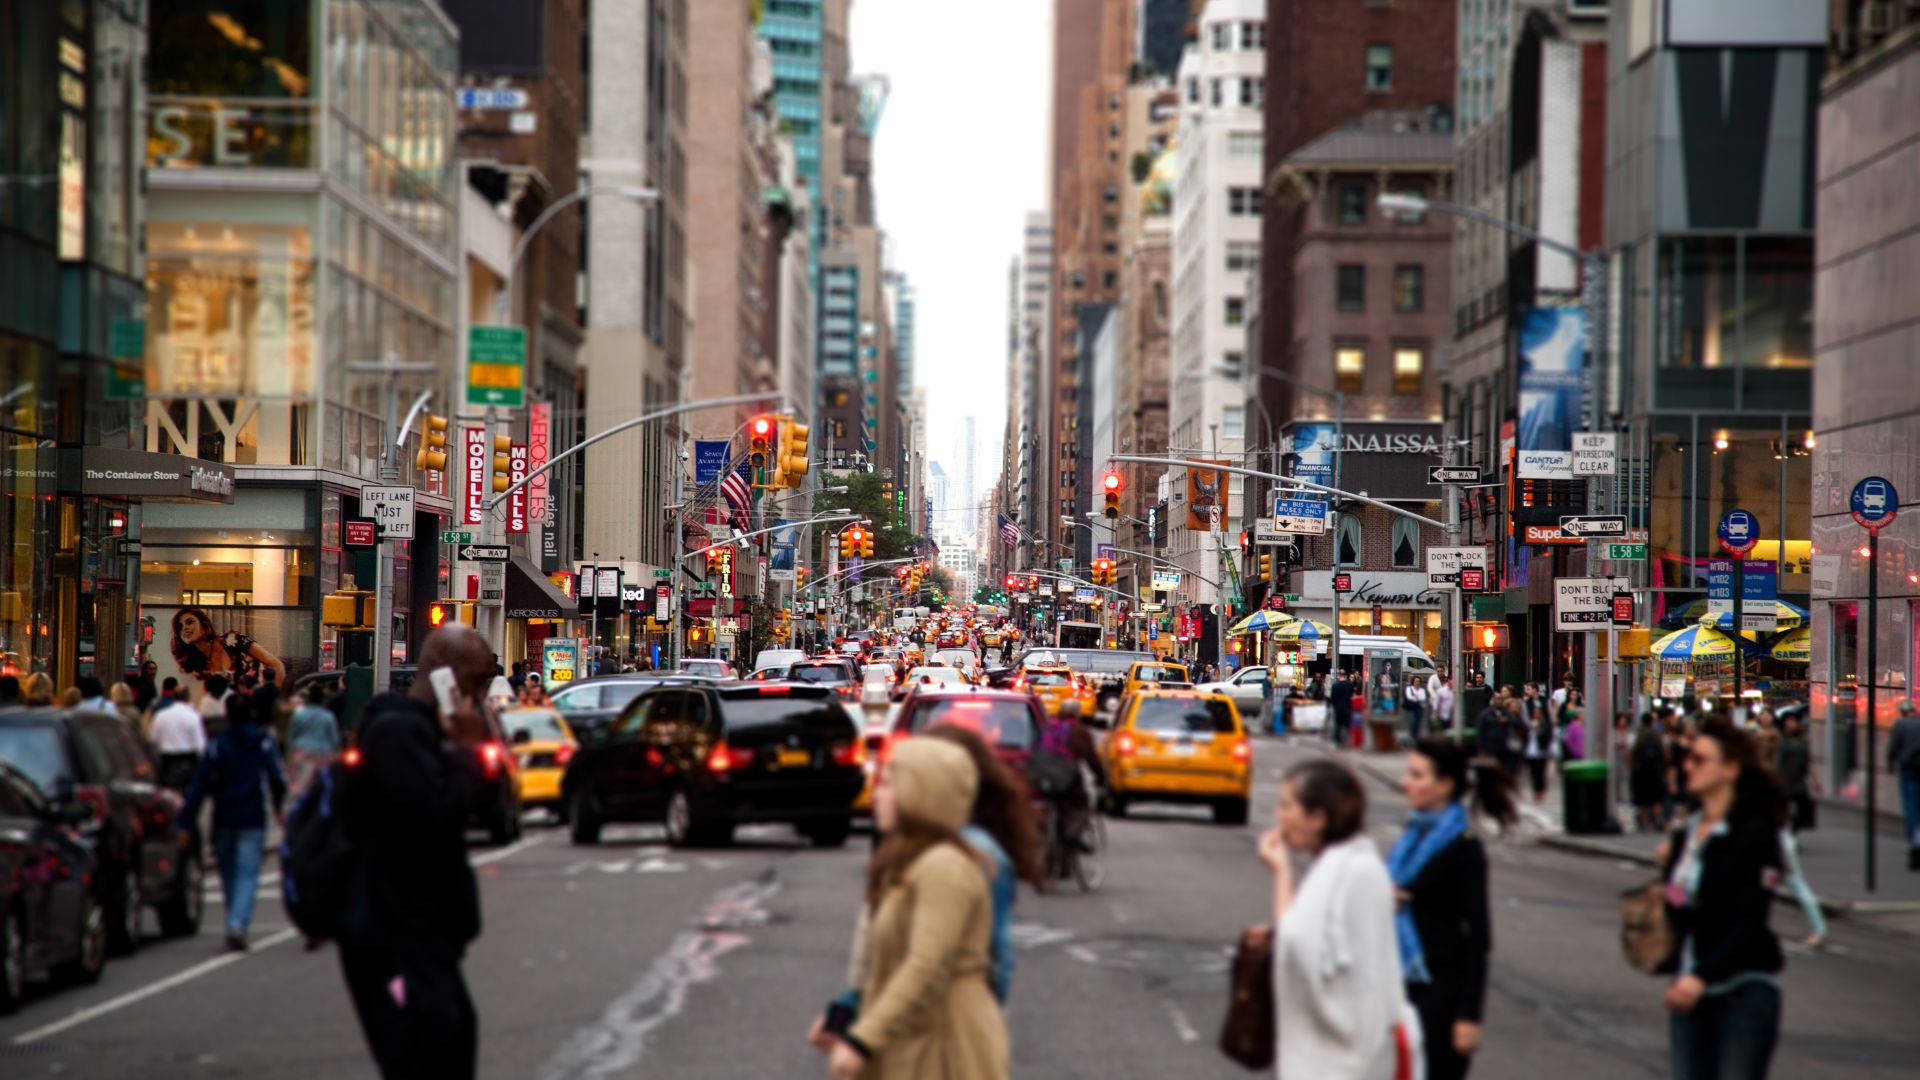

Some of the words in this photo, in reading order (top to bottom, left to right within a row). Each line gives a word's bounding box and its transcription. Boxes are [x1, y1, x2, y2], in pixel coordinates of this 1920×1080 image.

[146, 398, 258, 462] NY
[1333, 433, 1440, 454] ENAISSA
[1582, 438, 1605, 447] KEEP
[530, 404, 547, 518] AEROSOLES
[1580, 462, 1608, 471] CLEAR
[86, 470, 104, 479] The
[105, 470, 152, 480] Container
[154, 471, 180, 480] Store
[469, 430, 485, 522] MODELLS
[390, 493, 410, 501] LANE
[1568, 523, 1588, 531] ONE
[444, 534, 449, 542] E
[451, 534, 460, 543] 58
[545, 533, 557, 556] nail
[1612, 546, 1617, 557] E
[1621, 546, 1632, 557] 58
[1710, 562, 1729, 571] M101
[1710, 575, 1729, 584] M102
[1561, 586, 1588, 594] DON'T
[1593, 585, 1623, 594] BLOK
[1710, 588, 1729, 597] M103
[507, 609, 558, 617] AEROSOLES
[1278, 650, 1303, 664] OPEN
[553, 670, 572, 680] 200
